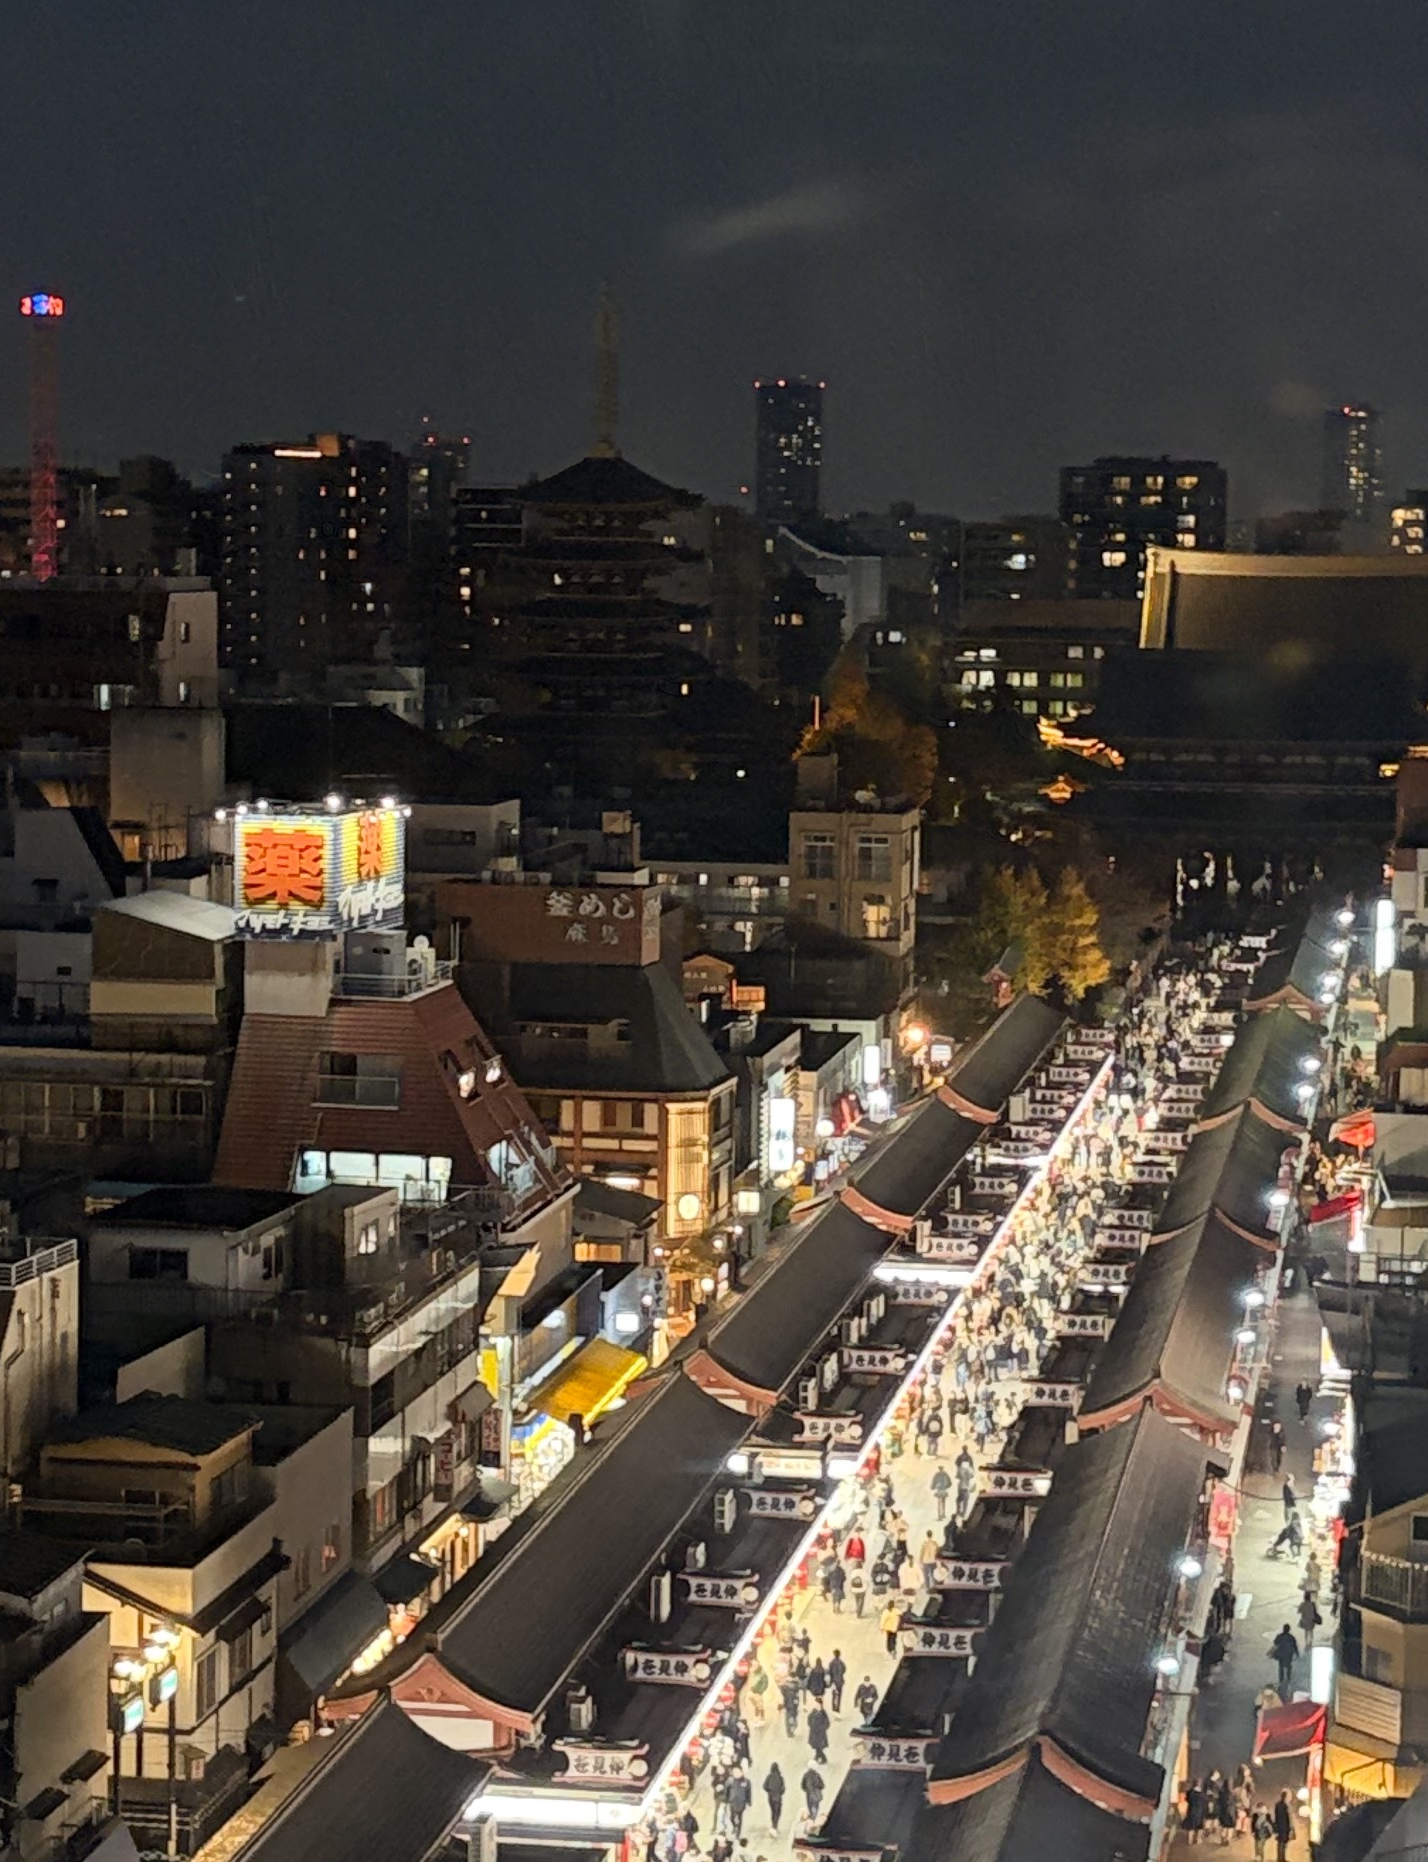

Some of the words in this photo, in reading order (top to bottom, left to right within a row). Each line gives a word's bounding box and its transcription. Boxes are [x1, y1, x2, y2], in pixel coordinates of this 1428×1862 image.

[243, 828, 324, 905] 薬
[545, 890, 636, 920] 釜めし
